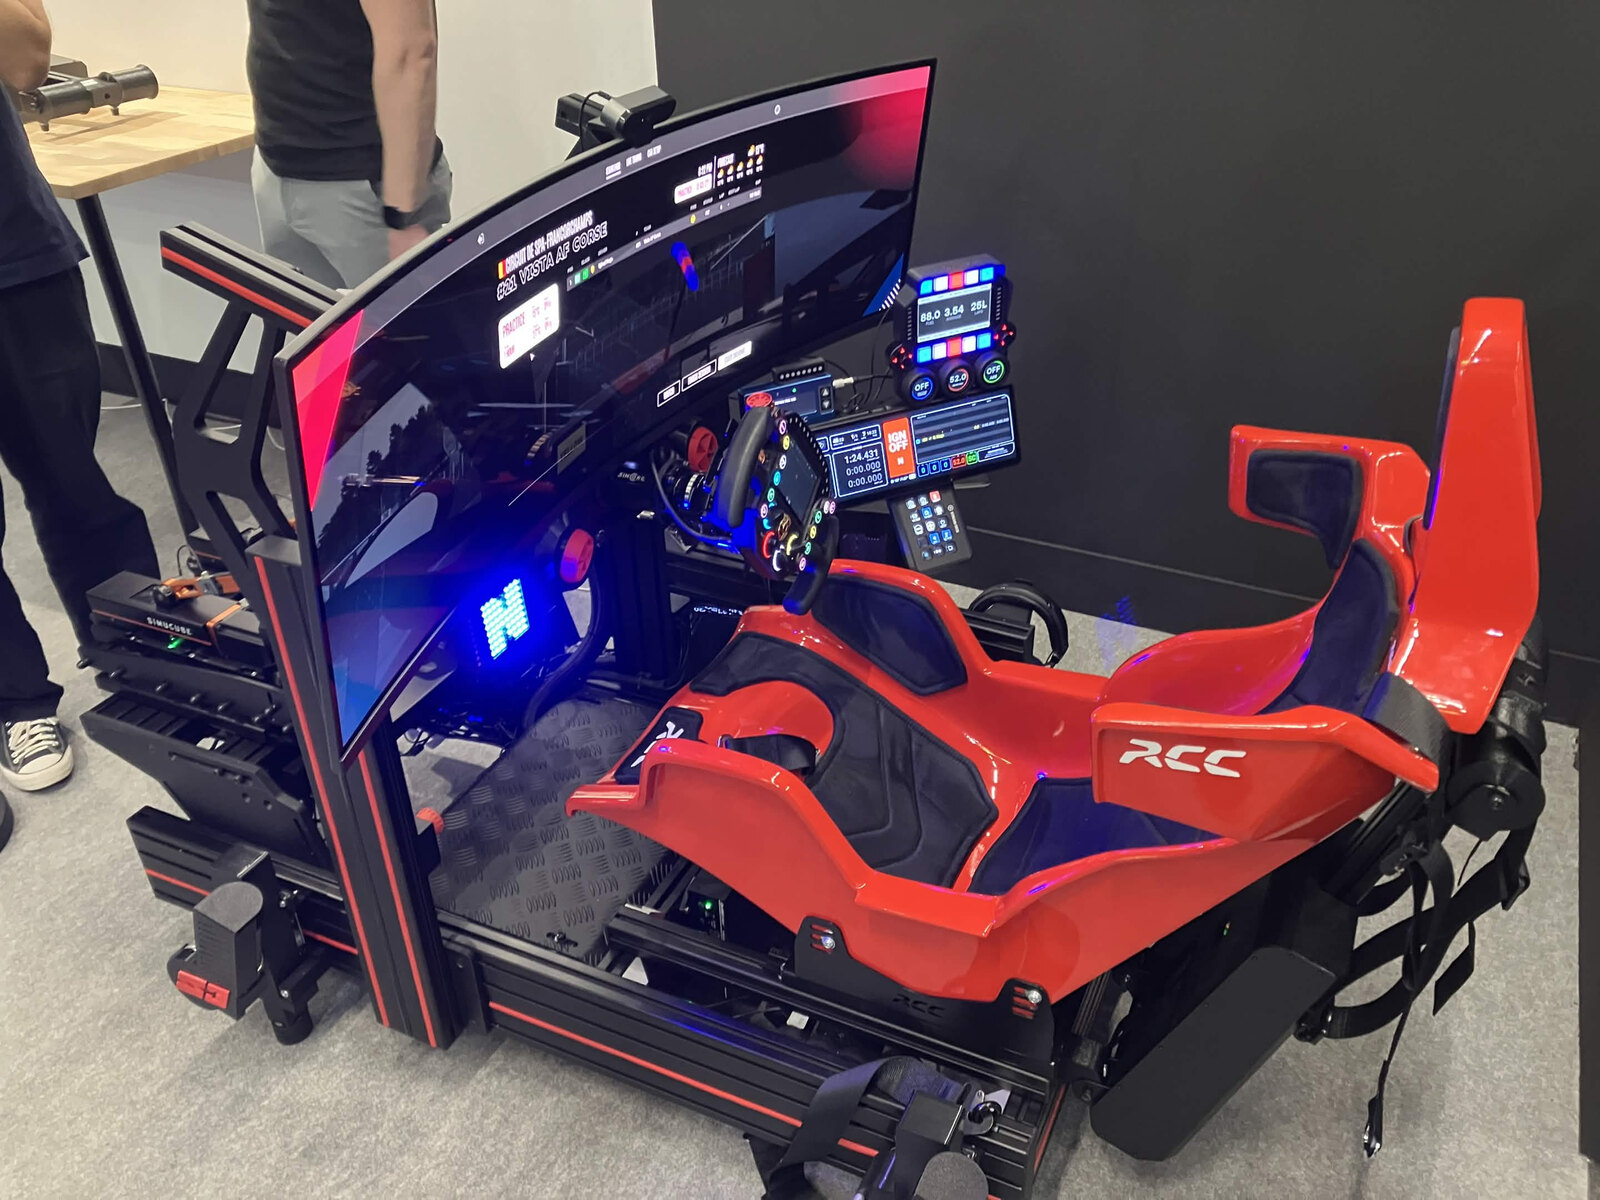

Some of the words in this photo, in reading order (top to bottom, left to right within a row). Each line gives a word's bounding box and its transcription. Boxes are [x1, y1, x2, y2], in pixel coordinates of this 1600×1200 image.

[497, 274, 517, 301] #21
[519, 252, 555, 285] VISTA
[556, 241, 570, 263] AF
[572, 220, 608, 252] CORSE
[506, 247, 527, 274] CIRCUIT
[527, 242, 535, 261] DE
[920, 310, 941, 322] 88.0
[944, 304, 964, 317] 3.54
[970, 300, 988, 311] 25L
[502, 311, 525, 338] PRACTICE
[986, 365, 1000, 375] OFF
[949, 373, 967, 384] 52.0
[914, 381, 930, 392] OFF
[887, 430, 907, 443] IGN
[889, 439, 908, 453] OFF
[844, 449, 878, 464] 1:24.431
[846, 461, 881, 476] 0:00.000
[848, 473, 882, 488] 0:00.000
[146, 616, 193, 636] SIMUCUBE
[1119, 738, 1247, 778] RCC
[893, 993, 945, 1018] RCC
